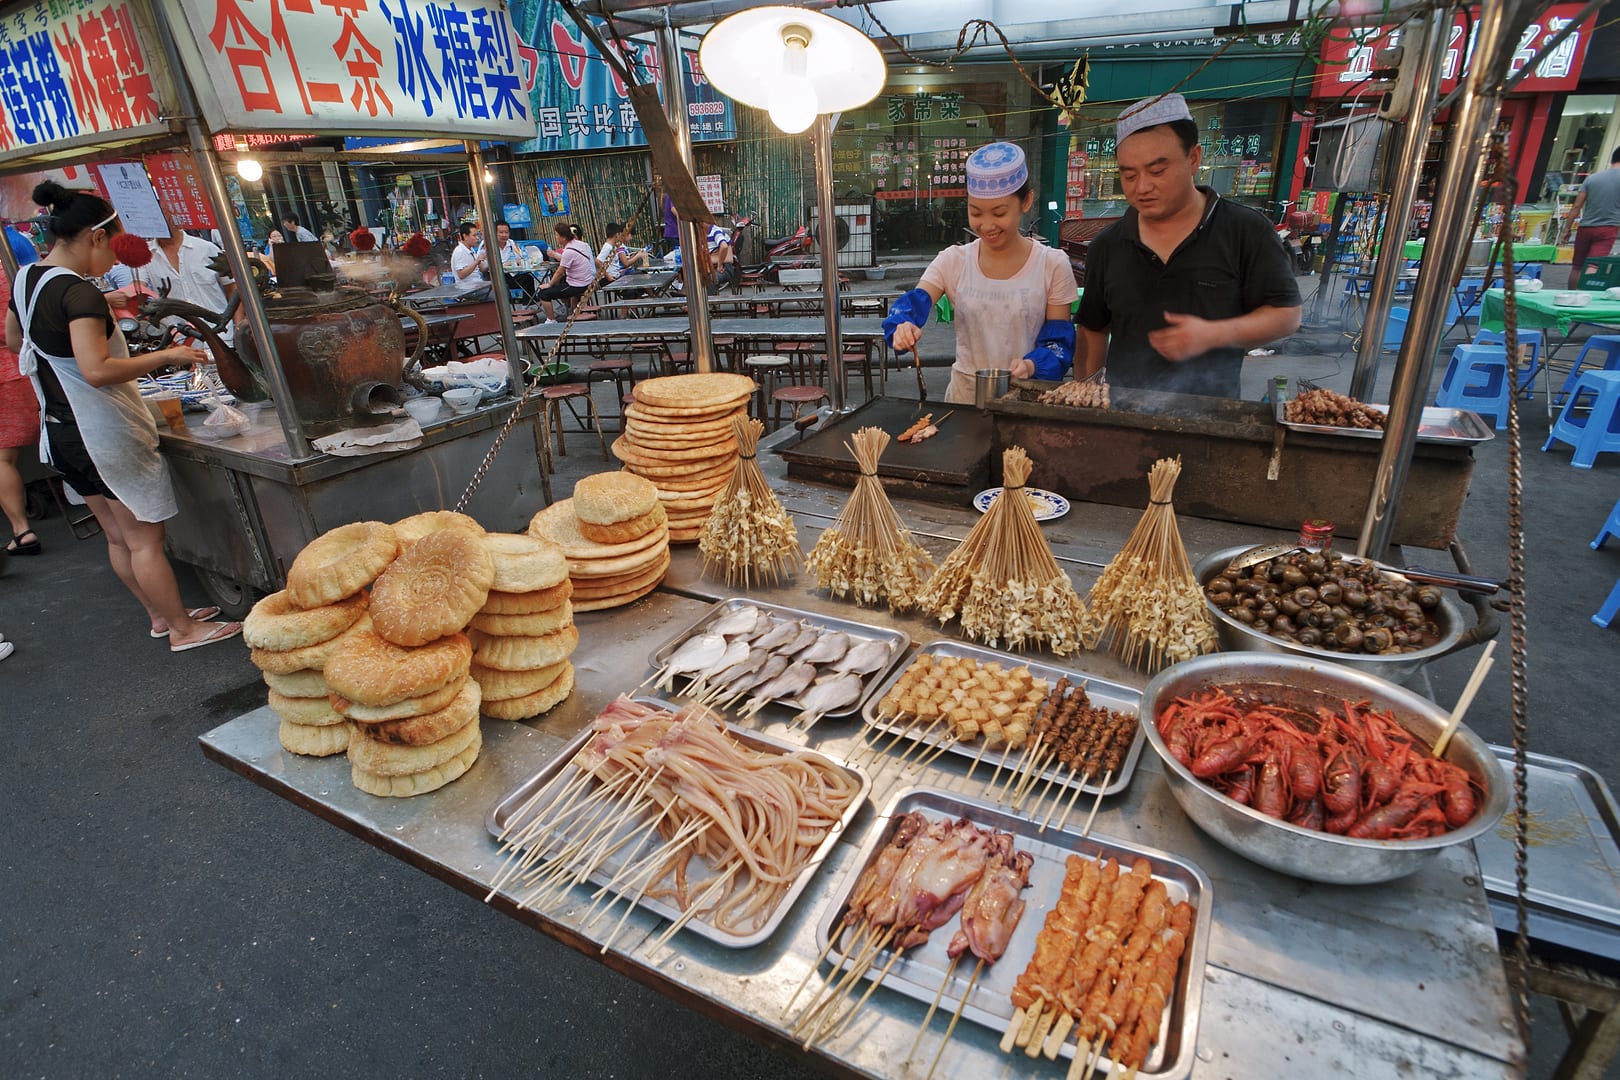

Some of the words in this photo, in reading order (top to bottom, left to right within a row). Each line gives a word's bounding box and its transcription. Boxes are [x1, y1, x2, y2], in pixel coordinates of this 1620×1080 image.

[208, 0, 394, 117] 杏仁茶
[379, 0, 527, 121] 冰糖梨
[689, 102, 724, 116] 5936829
[887, 92, 961, 121] 家常菜
[1086, 138, 1116, 160] 中华
